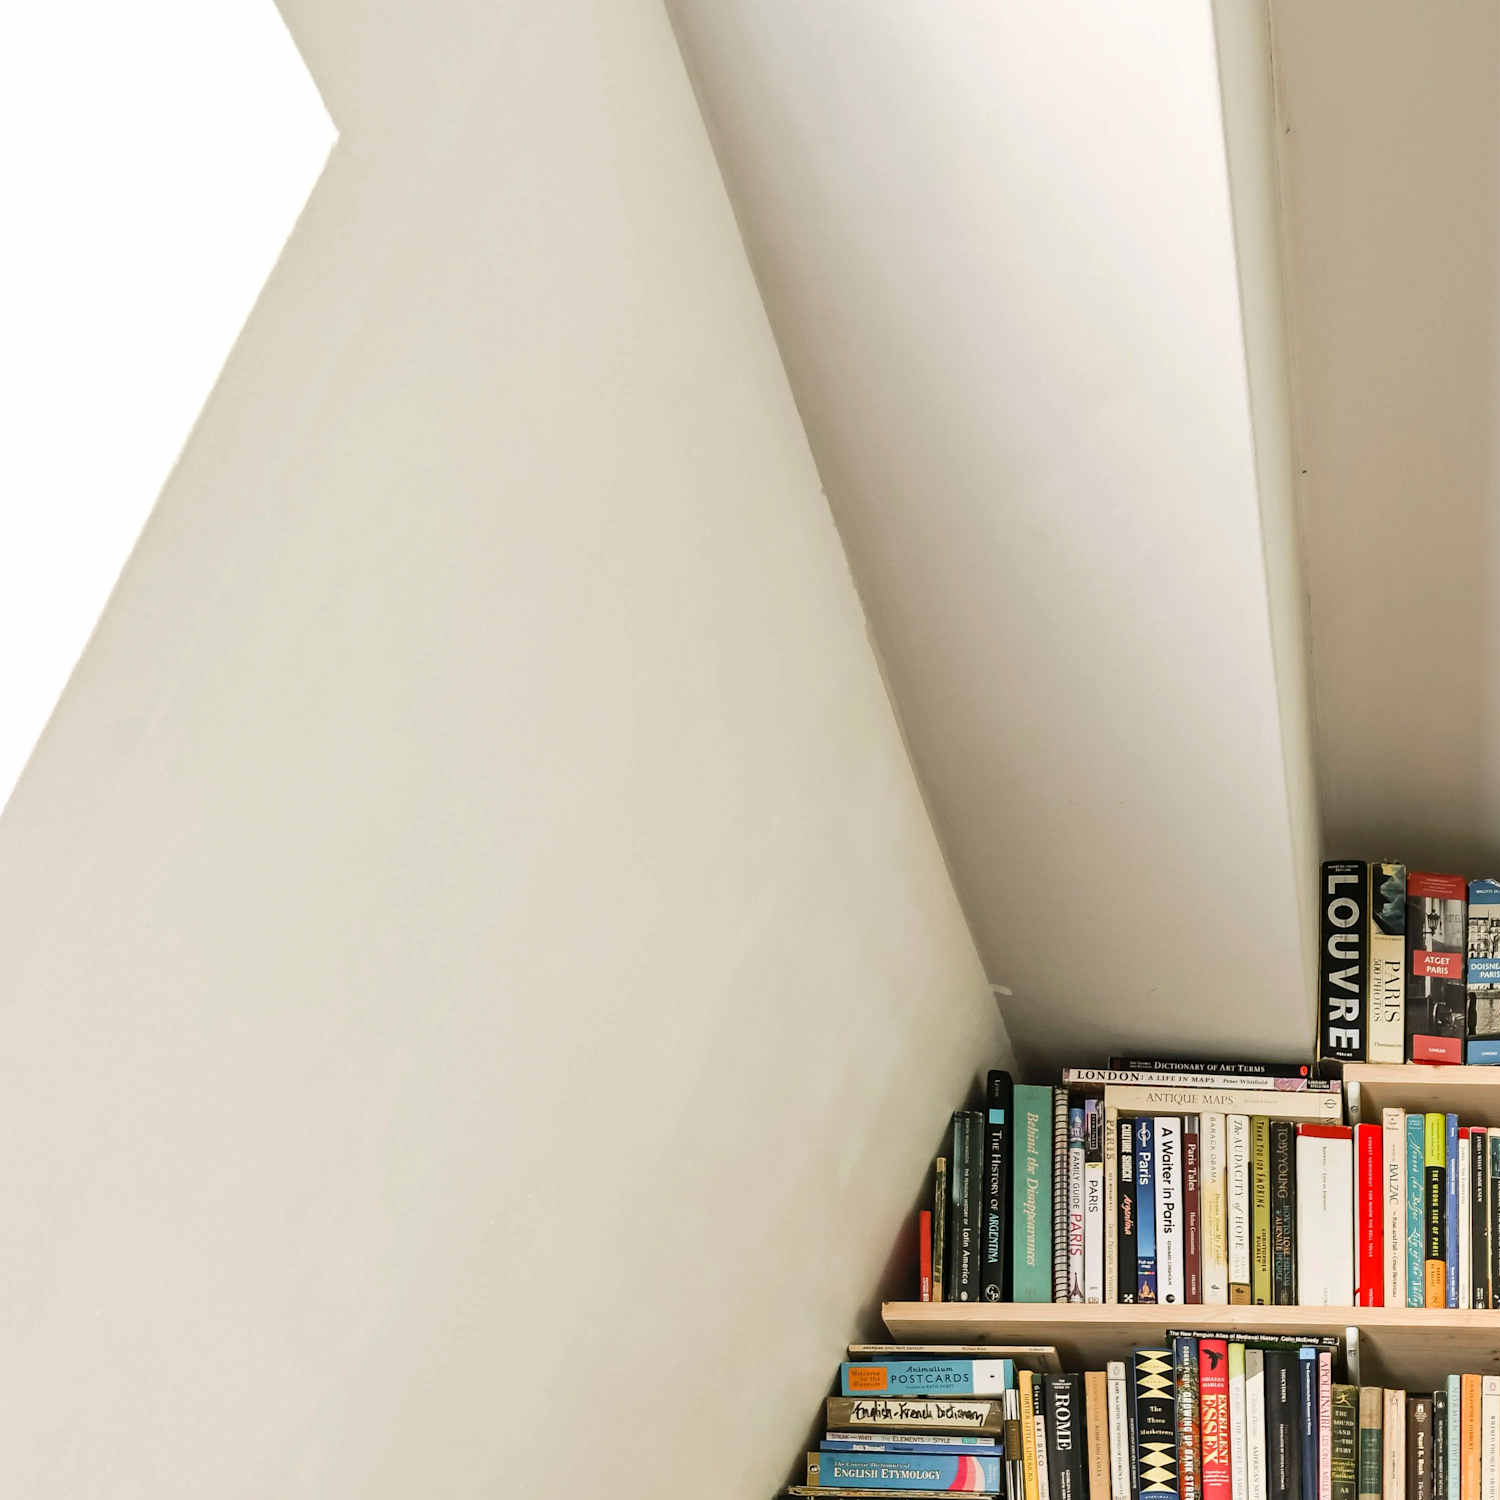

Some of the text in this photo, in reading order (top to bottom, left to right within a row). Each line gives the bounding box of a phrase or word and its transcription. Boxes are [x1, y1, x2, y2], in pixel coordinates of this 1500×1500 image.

[1327, 874, 1359, 1049] LOUVRE
[1424, 957, 1450, 965] ATGET
[1426, 966, 1448, 975] PARIS
[1480, 971, 1500, 979] PARIS
[1373, 977, 1382, 1022] PHOTOS
[1385, 960, 1401, 1022] PARIS
[1154, 1061, 1264, 1072] DICTIONARY OF ART TERMS
[1145, 1092, 1233, 1105] ANTIQUE MAPS
[1209, 1117, 1218, 1184] BARACK OBAMA
[1233, 1120, 1243, 1136] The
[990, 1154, 1001, 1196] HISTORY
[1139, 1152, 1152, 1184] Paris
[1162, 1127, 1175, 1233] A Waiter in Paris
[1188, 1144, 1197, 1191] Paris Tales
[1233, 1137, 1243, 1197] AUDACITY
[1277, 1128, 1289, 1198] TOBY YOUNG
[1389, 1164, 1399, 1204] BALZAC
[1070, 1151, 1082, 1255] FAMILY GUIDE PARIS
[1088, 1180, 1098, 1212] PARIS
[988, 1214, 999, 1262] ARGENTINA
[1234, 1216, 1244, 1248] HOPE
[961, 1228, 970, 1284] Latin America
[891, 1373, 969, 1384] POSTCARDS
[1055, 1393, 1071, 1450] ROME
[1203, 1394, 1218, 1465] ESSEX
[1218, 1394, 1228, 1466] EXCELLENT
[834, 1467, 941, 1480] ENGLISH ETYMOLOGY
